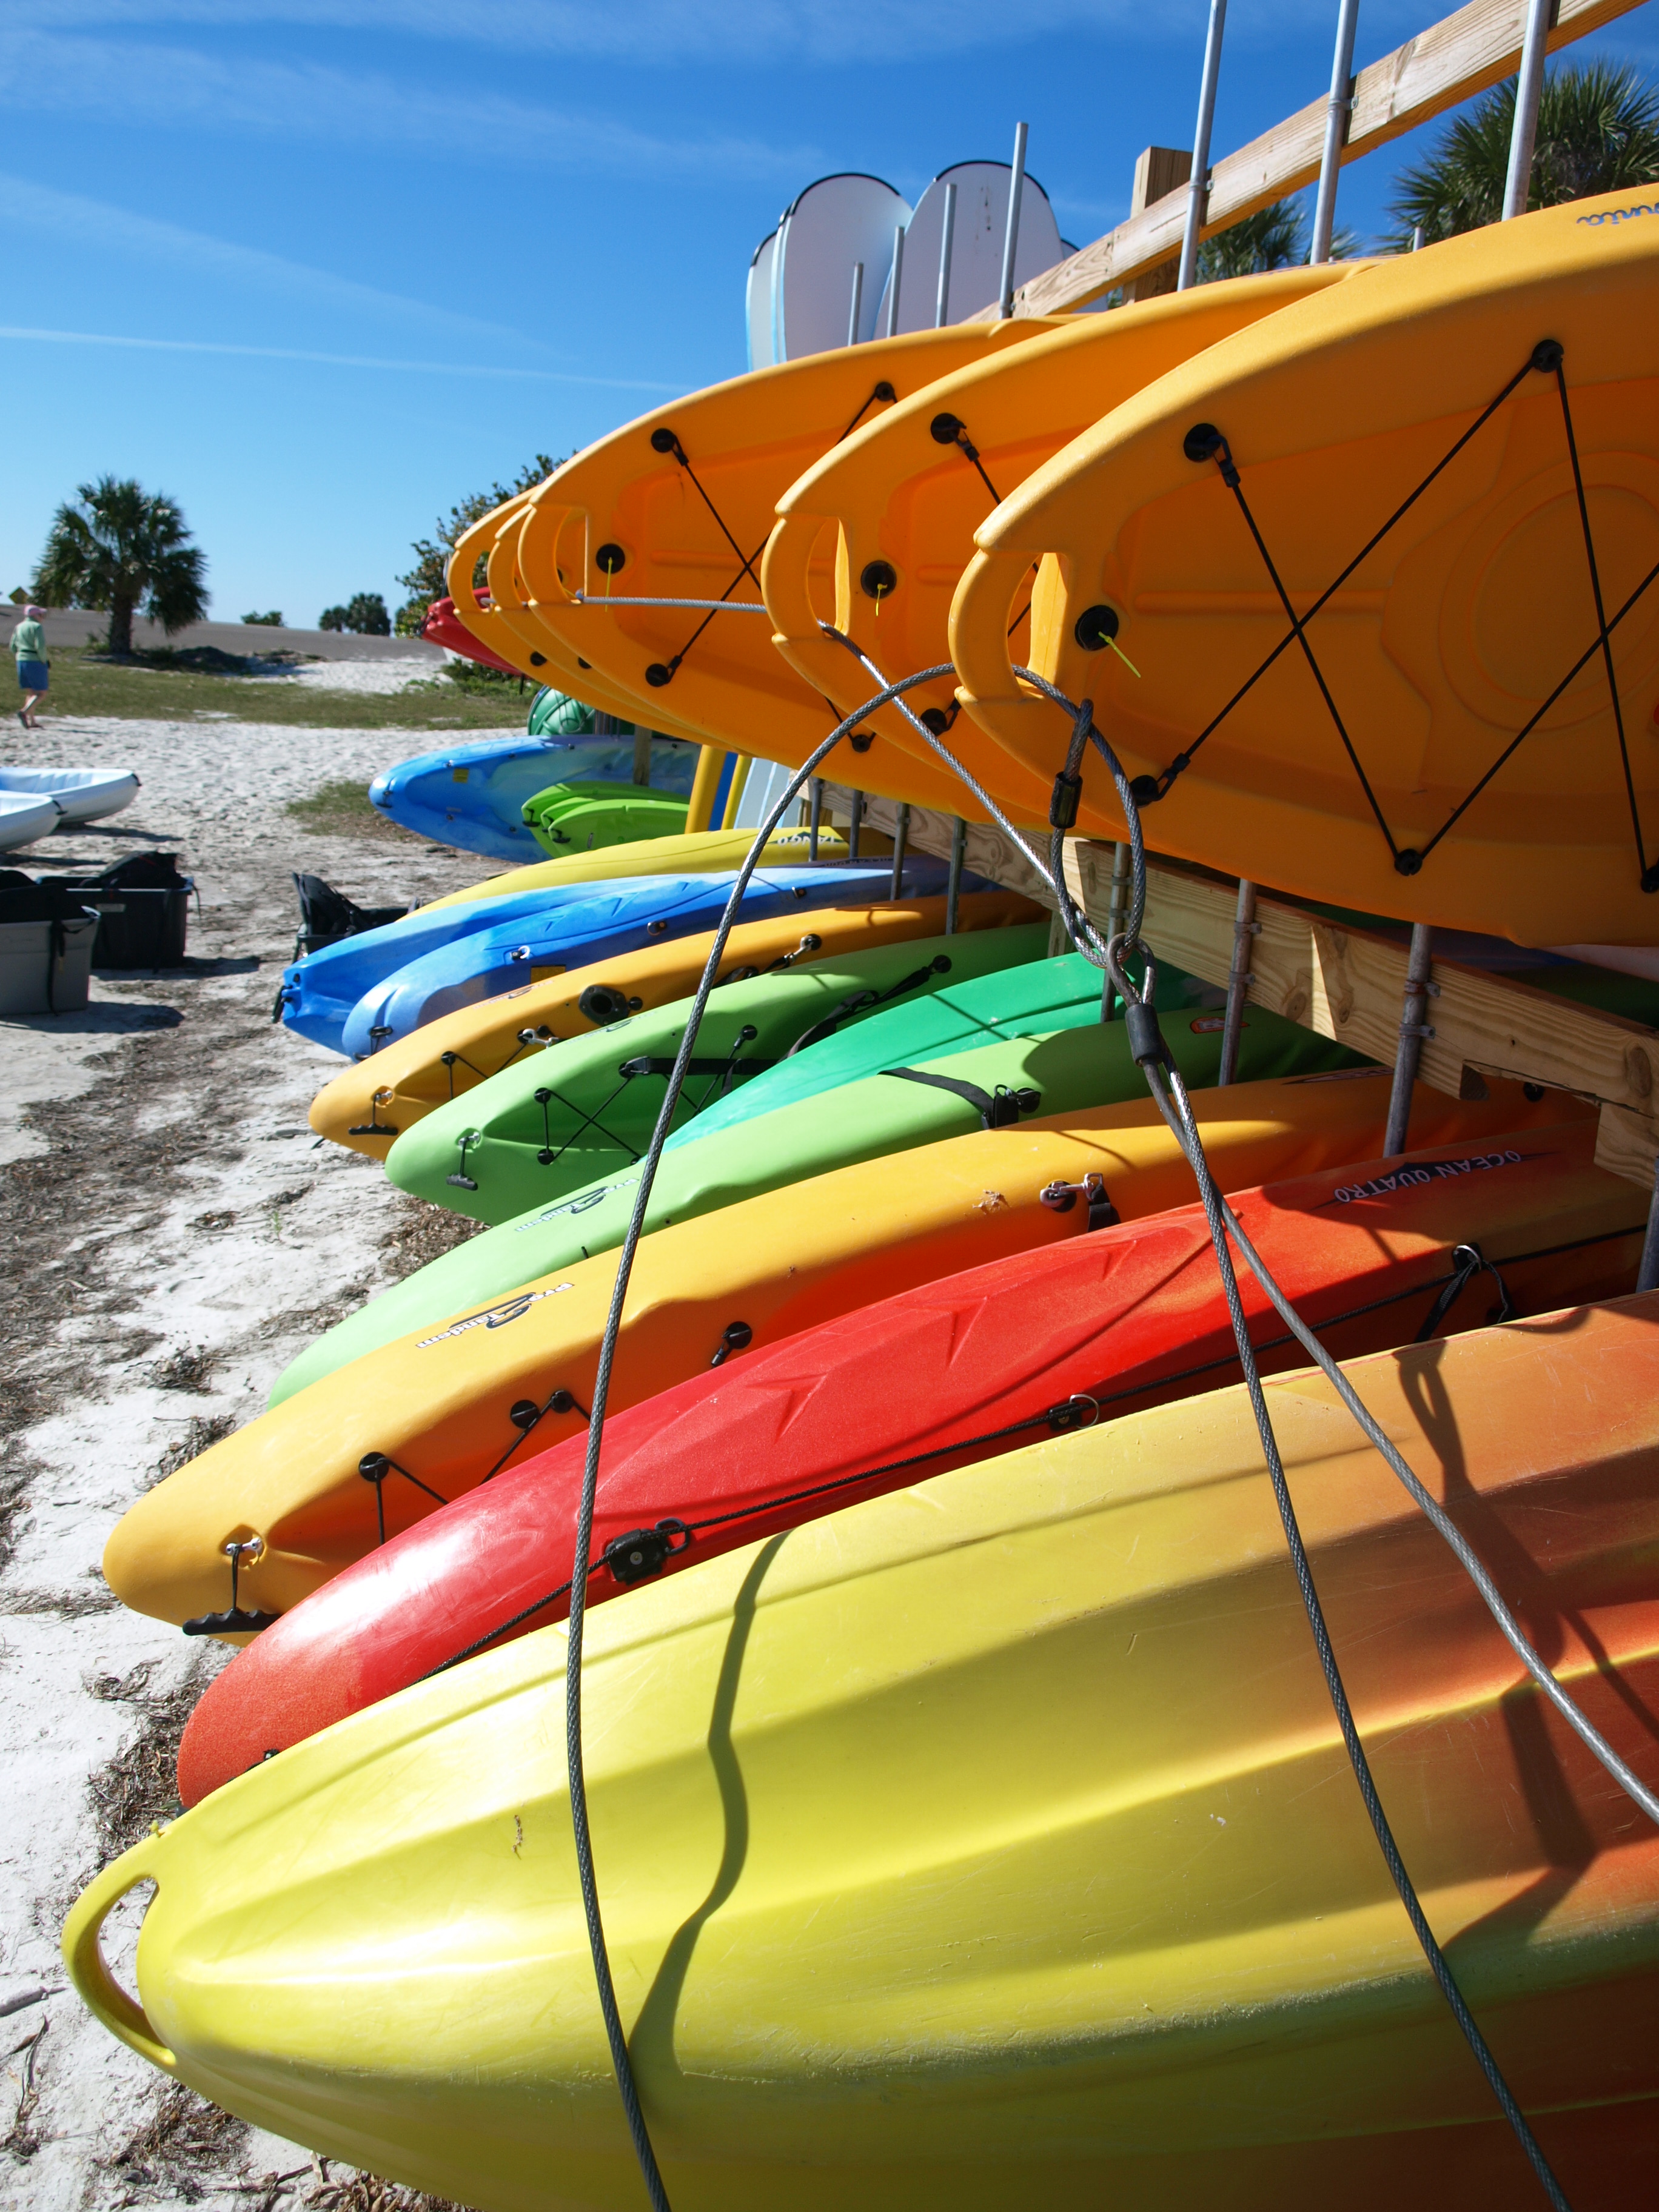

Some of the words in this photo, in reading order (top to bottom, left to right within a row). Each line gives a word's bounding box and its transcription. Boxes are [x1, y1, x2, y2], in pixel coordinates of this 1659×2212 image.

[777, 834, 840, 846] TANGO
[1435, 1150, 1523, 1179] OCEAN
[1333, 1169, 1431, 1204] QUATRO
[529, 1282, 575, 1302] Pro
[415, 1312, 506, 1349] Tandem
